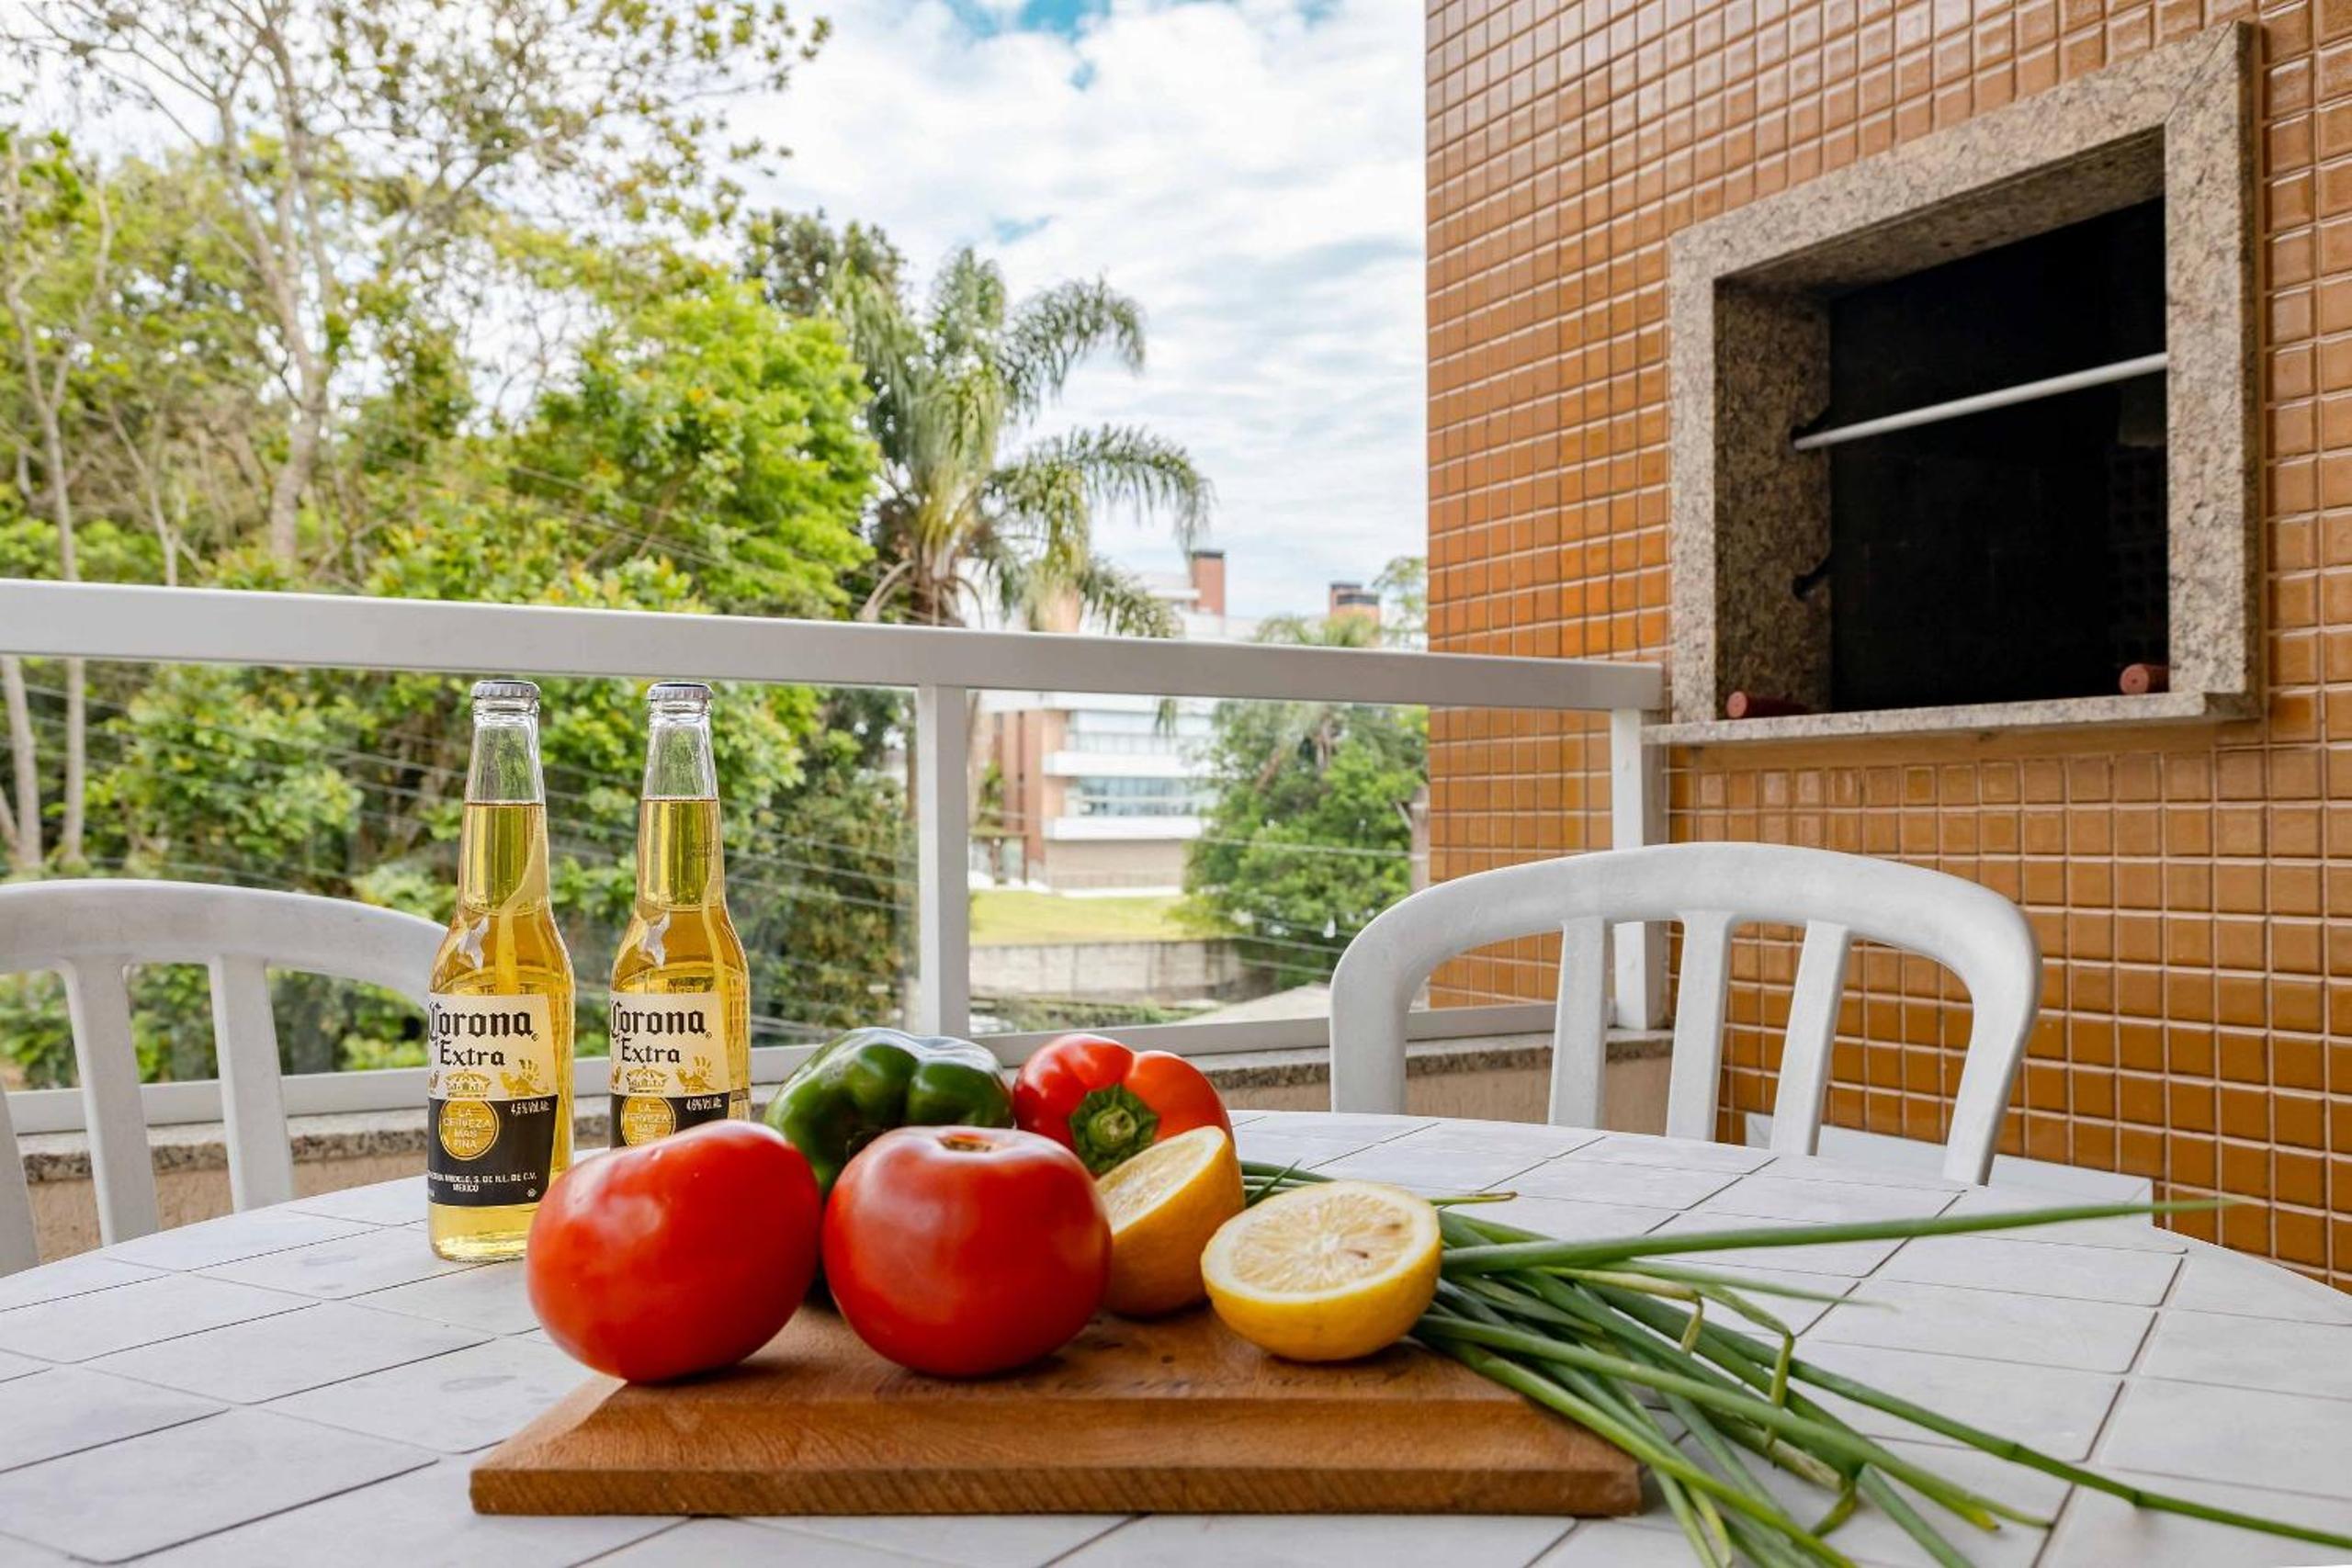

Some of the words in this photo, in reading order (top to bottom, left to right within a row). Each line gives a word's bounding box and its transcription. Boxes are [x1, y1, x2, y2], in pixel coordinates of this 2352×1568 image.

[429, 1001, 534, 1041] Corona
[610, 999, 707, 1039] Corona
[440, 1040, 506, 1066] Extra
[622, 1036, 681, 1063] Extra
[443, 1117, 492, 1129] CERVEZA
[458, 1108, 472, 1118] LA
